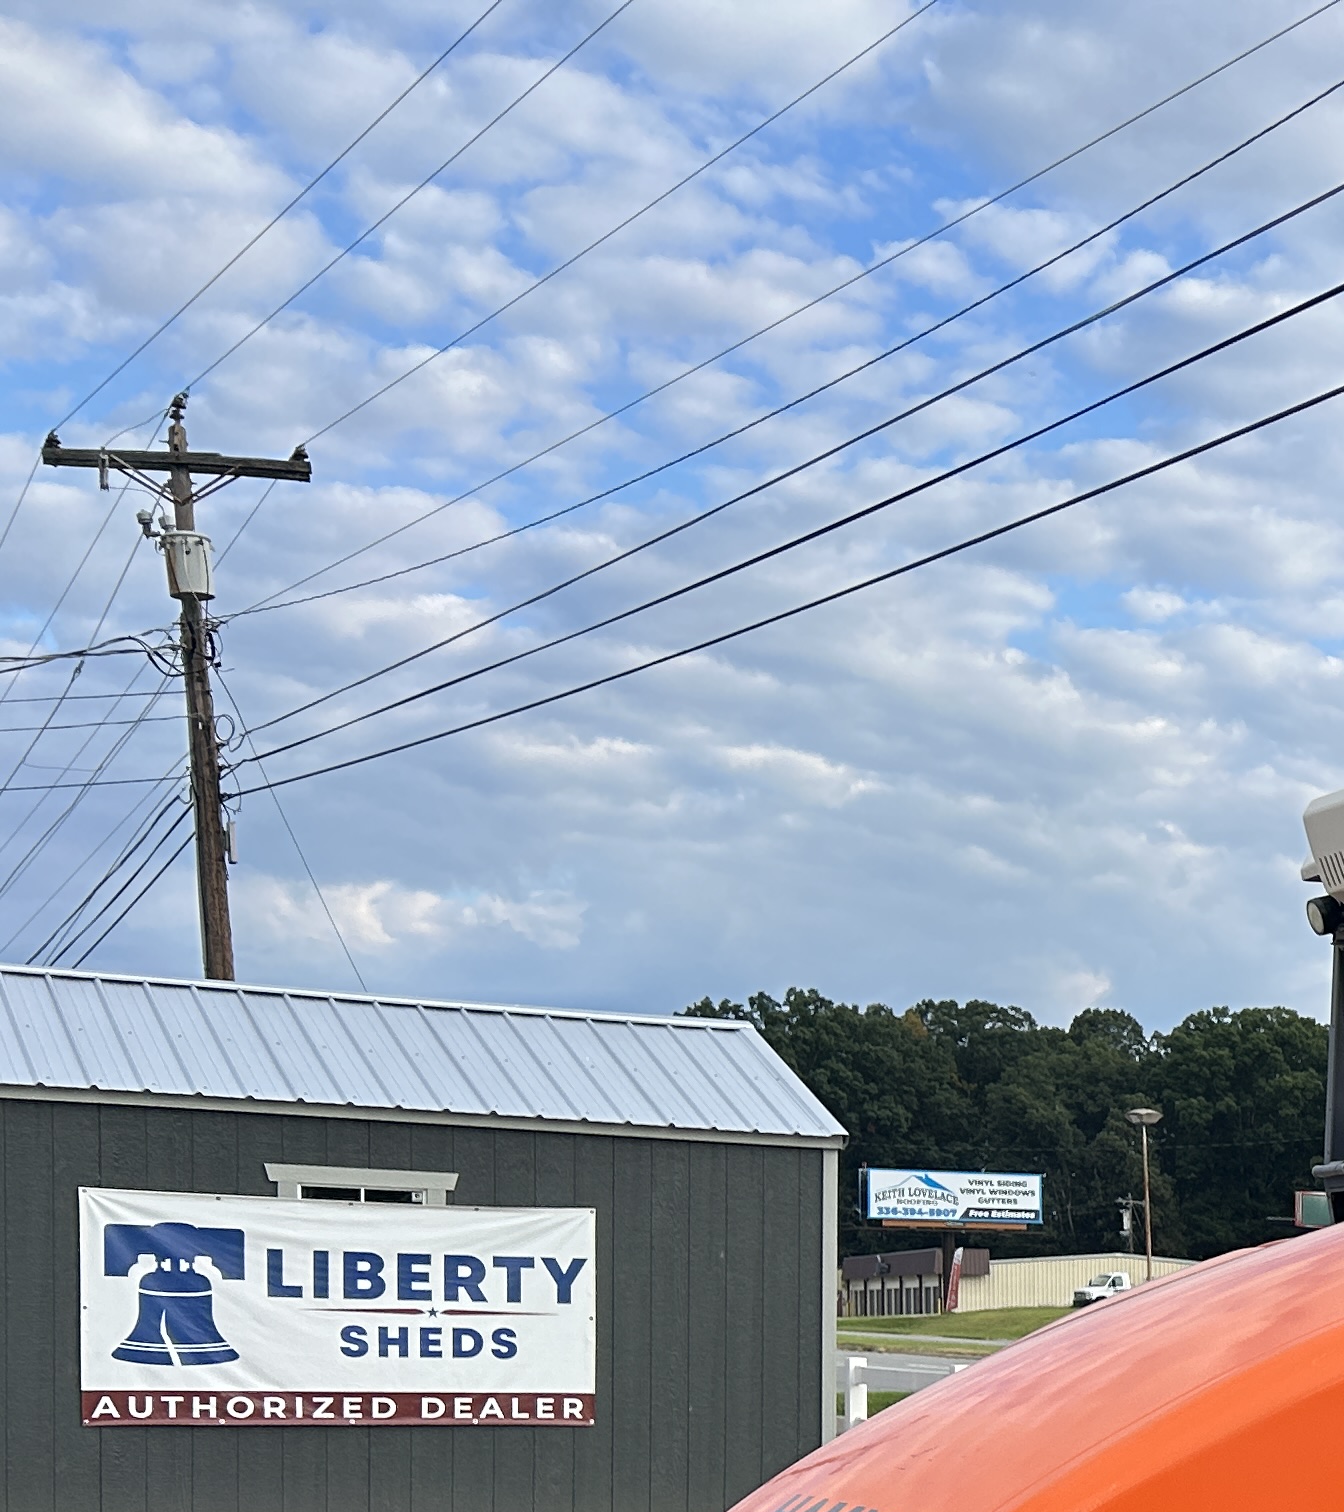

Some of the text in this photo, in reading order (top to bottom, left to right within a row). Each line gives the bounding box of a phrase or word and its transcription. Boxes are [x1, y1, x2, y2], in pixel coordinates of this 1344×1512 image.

[874, 1186, 960, 1206] KEITH LOVELACE
[266, 1248, 588, 1305] LIBERTY
[339, 1324, 518, 1360] SHEDS
[91, 1394, 585, 1420] AUTHORIZED DEALER
